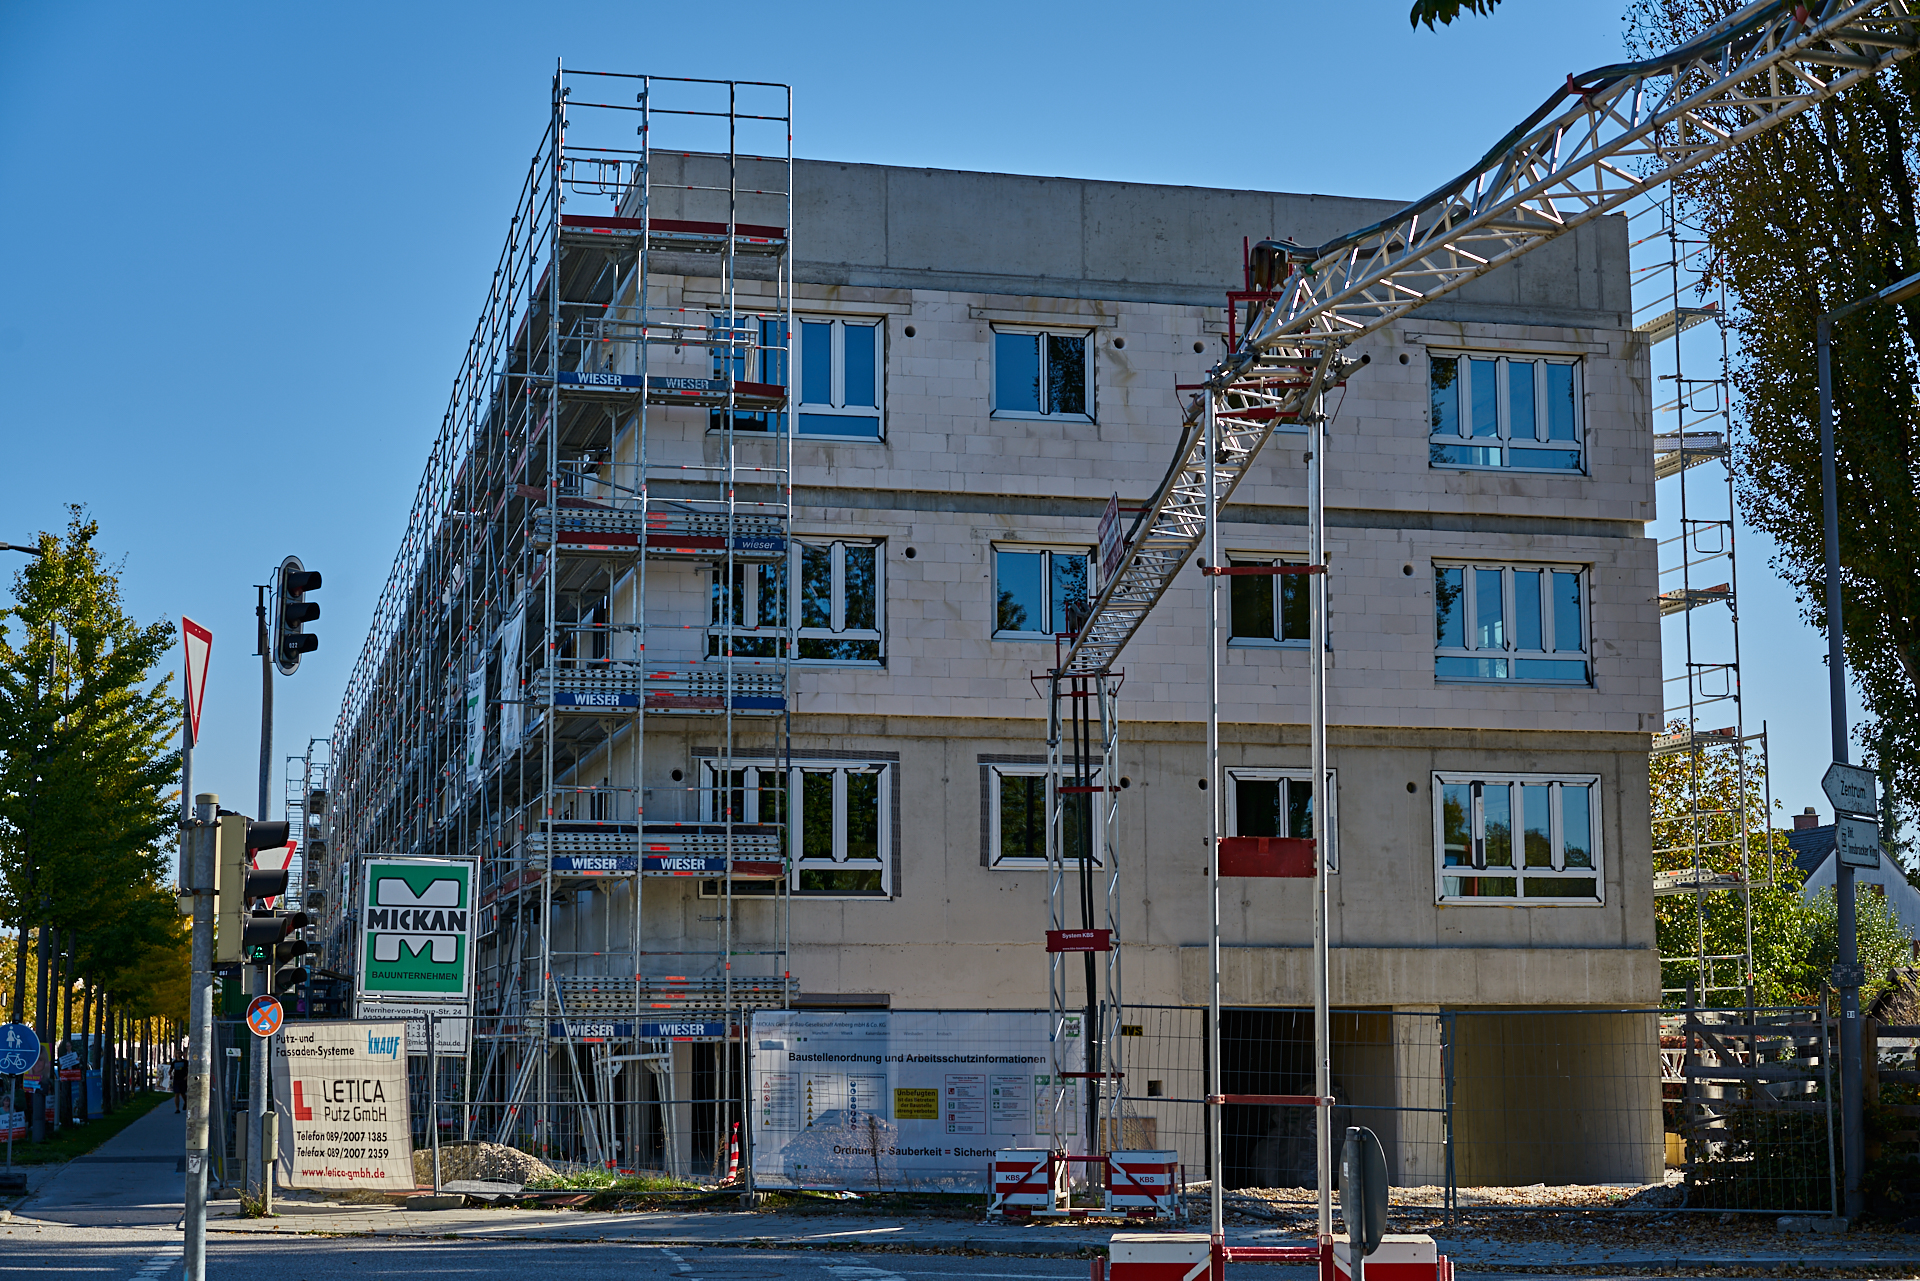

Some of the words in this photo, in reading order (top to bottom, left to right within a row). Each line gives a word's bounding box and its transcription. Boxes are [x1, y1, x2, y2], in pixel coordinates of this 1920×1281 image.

[578, 373, 622, 385] WIESER
[666, 378, 709, 389] WIESER
[742, 539, 775, 549] wieser
[574, 693, 620, 706] WIESER
[1841, 781, 1866, 799] Zentrum
[572, 858, 617, 869] WIESER
[661, 858, 705, 870] WIESER
[367, 908, 467, 932] MICKAN
[372, 971, 458, 981] BAUUNTERNEHMEN
[568, 1024, 614, 1037] WIESER
[659, 1023, 705, 1035] WIESER
[276, 1034, 298, 1044] Putz-
[299, 1031, 314, 1043] und
[368, 1029, 400, 1060] KNAUF
[276, 1045, 354, 1059] Fassaden-Systeme
[788, 1052, 882, 1064] Baustellenordnung
[884, 1053, 904, 1063] und
[906, 1053, 1046, 1064] Arbeitsschutzinformationen
[323, 1080, 386, 1103] LETICA
[897, 1089, 936, 1097] Unbefugten
[325, 1107, 350, 1122] Putz
[353, 1106, 387, 1122] GmbH
[296, 1130, 325, 1141] Telefon
[326, 1131, 366, 1144] 089/2007
[367, 1131, 388, 1142] 1385
[296, 1146, 325, 1158] Telefax
[327, 1147, 366, 1159] 089/2007
[368, 1148, 389, 1159] 2359
[833, 1145, 876, 1157] Ordnung
[888, 1146, 942, 1156] Sauberkeit
[954, 1147, 996, 1157] Sicherhe
[301, 1166, 386, 1181] www.letica-gmbh.de
